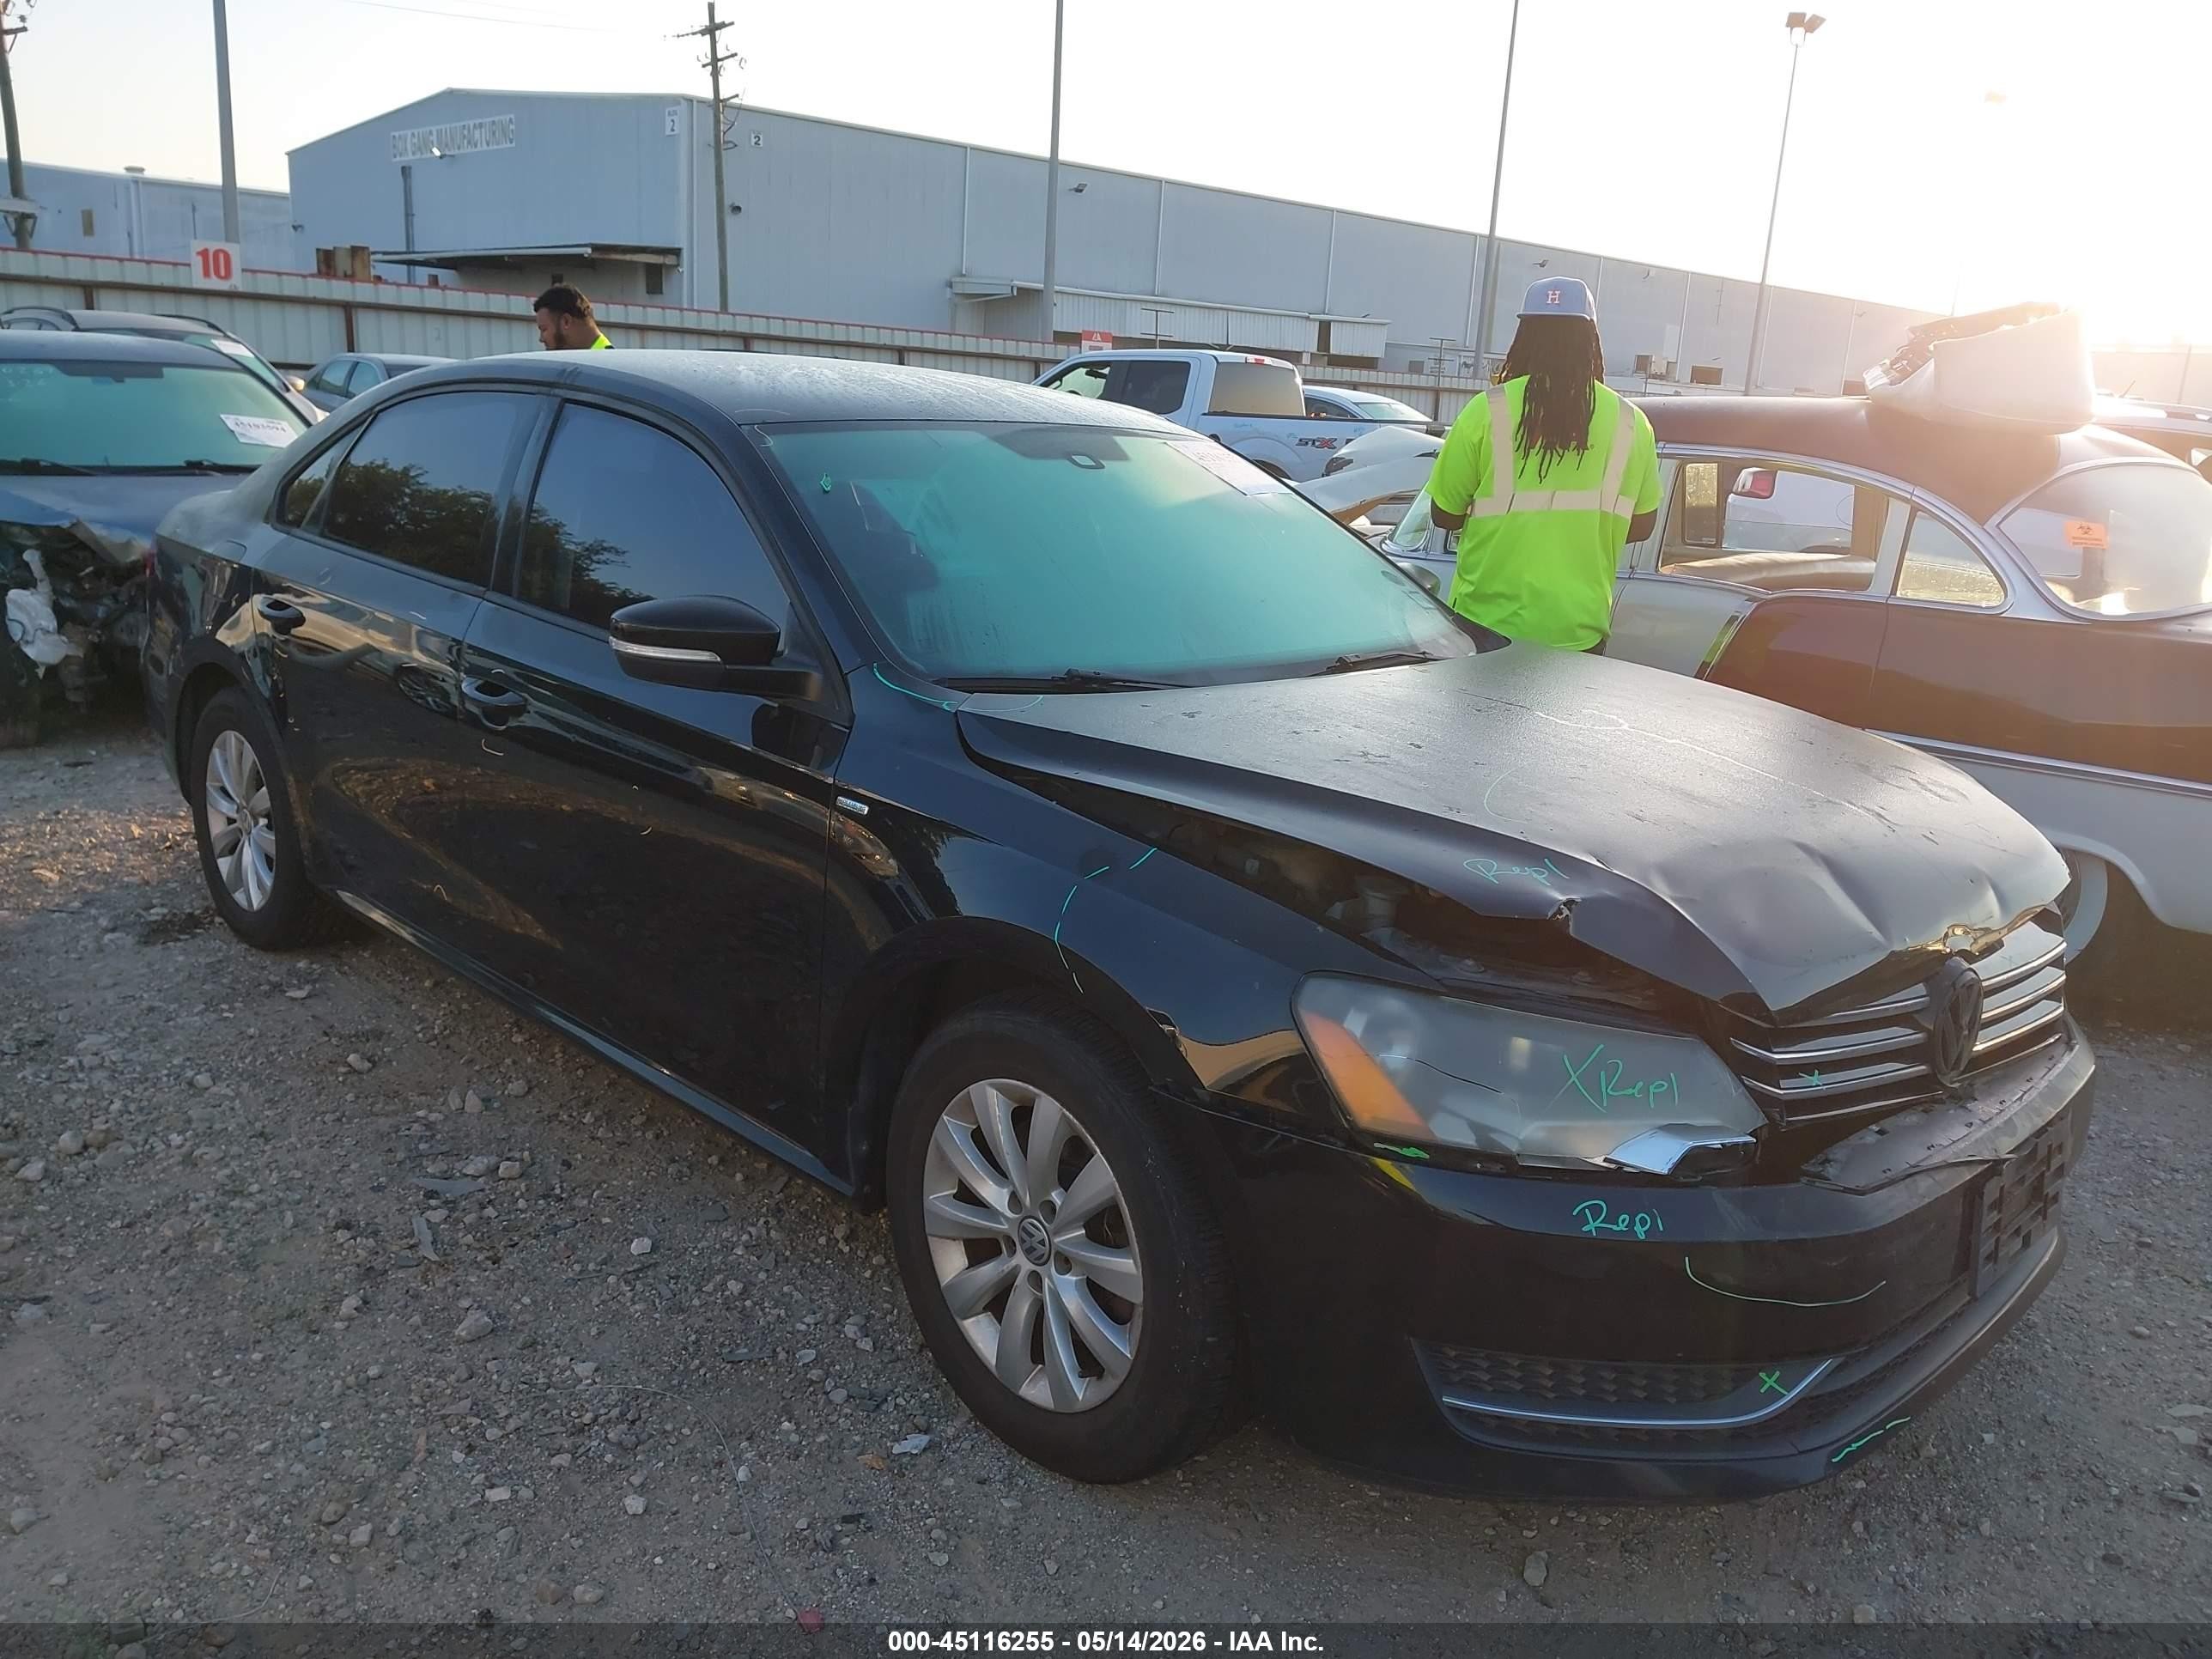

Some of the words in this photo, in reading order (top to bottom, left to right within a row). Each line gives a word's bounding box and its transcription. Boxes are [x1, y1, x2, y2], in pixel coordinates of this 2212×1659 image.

[435, 116, 514, 152] MANUFACTURING
[753, 135, 761, 146] 2
[196, 247, 233, 281] 10
[1546, 290, 1561, 304] H
[1295, 436, 1337, 449] STX
